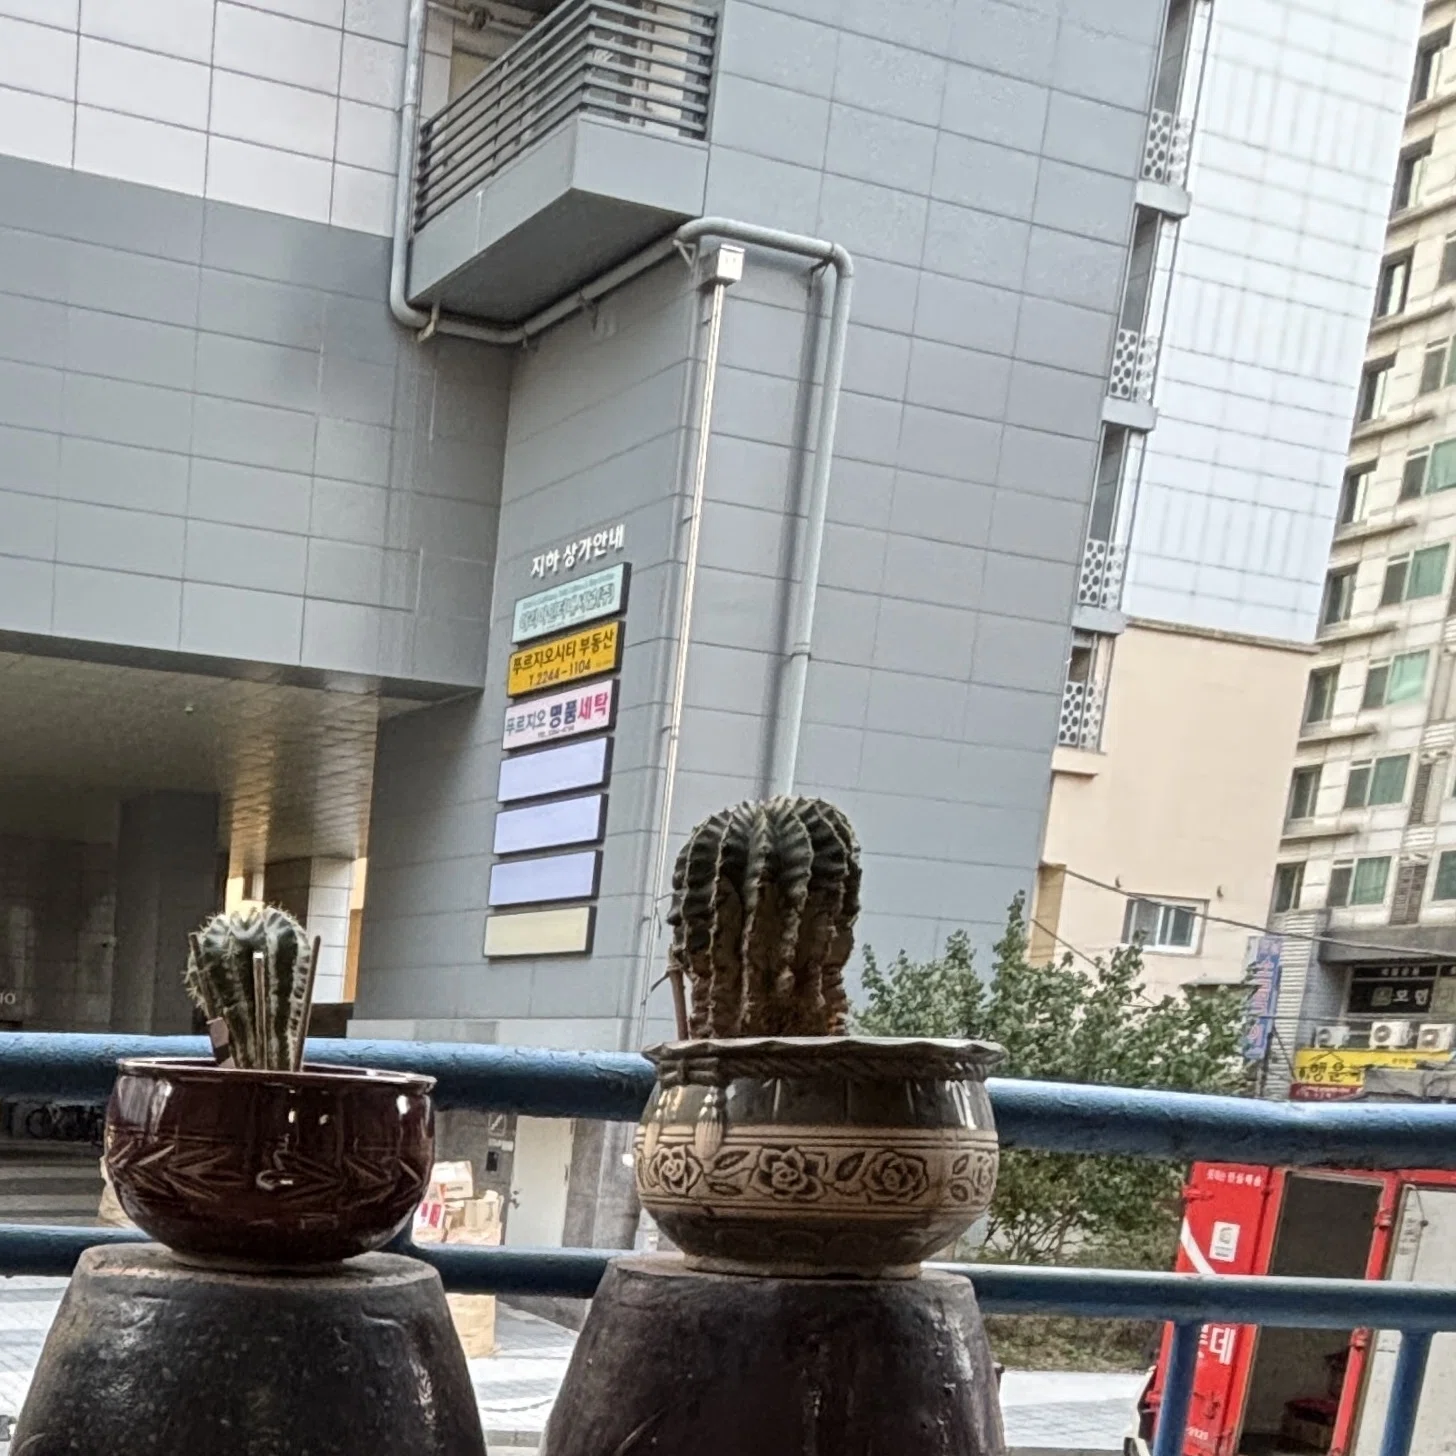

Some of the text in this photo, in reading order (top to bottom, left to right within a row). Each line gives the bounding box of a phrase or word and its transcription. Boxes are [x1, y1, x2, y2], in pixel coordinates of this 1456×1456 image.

[530, 524, 625, 578] 지하 상가안내
[513, 629, 614, 675] 푸르지오시티 부동산
[506, 709, 546, 736] 푸르지오
